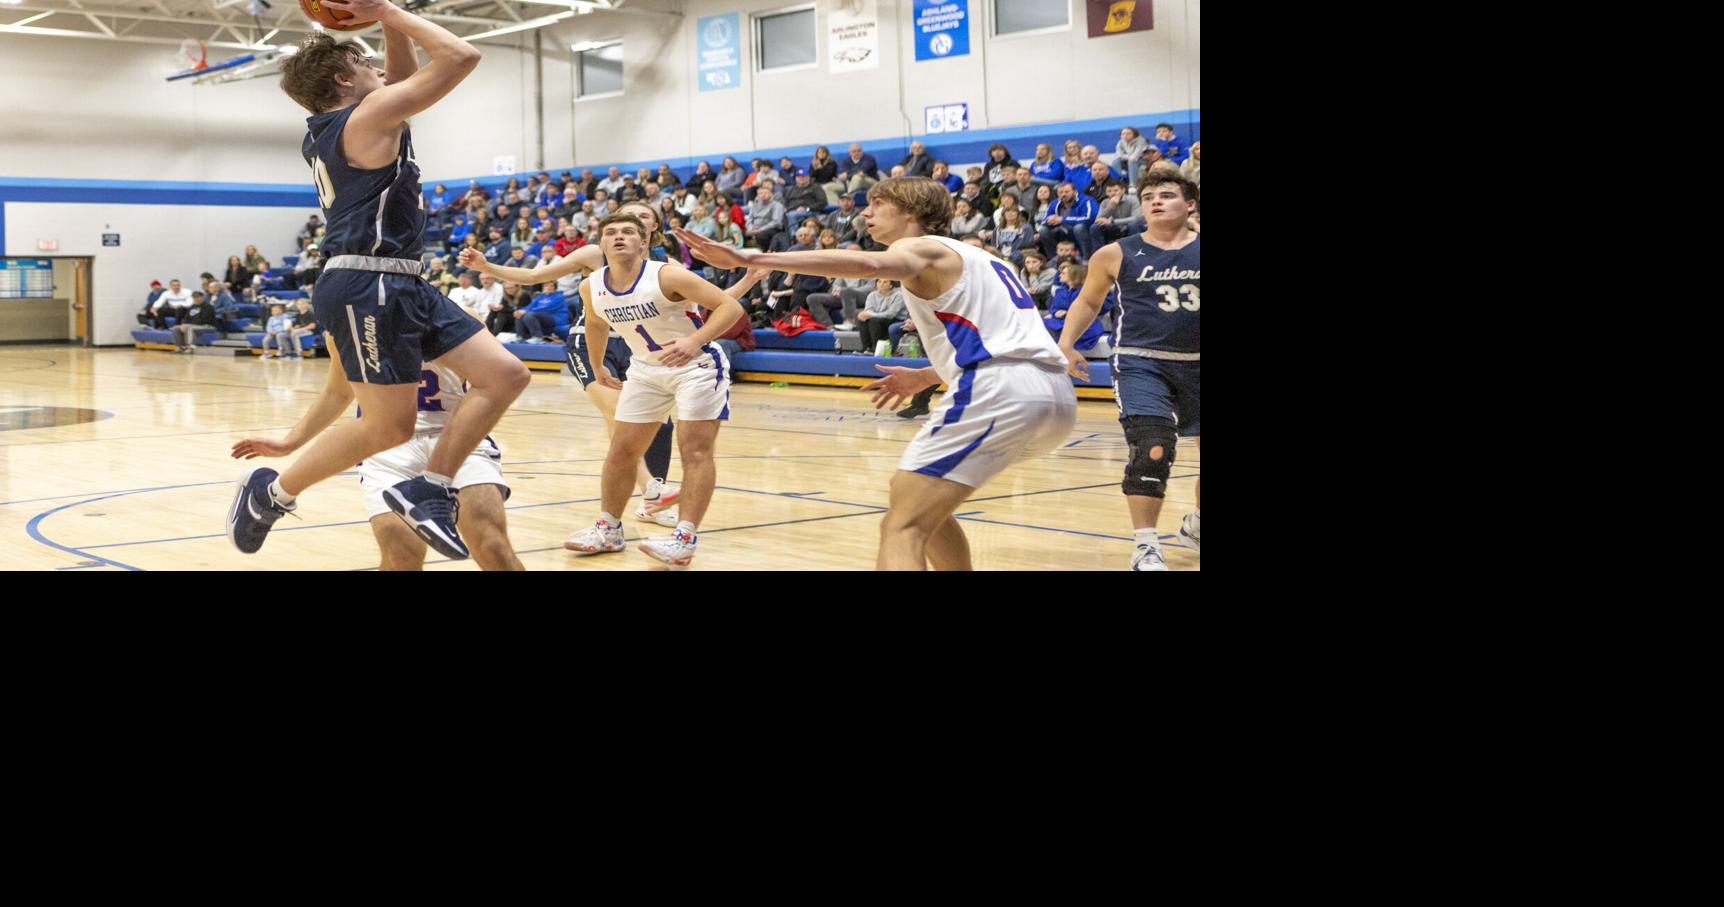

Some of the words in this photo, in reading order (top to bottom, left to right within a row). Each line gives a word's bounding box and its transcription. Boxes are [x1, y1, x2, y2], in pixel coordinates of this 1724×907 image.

[917, 10, 965, 26] GREENWOOD
[922, 20, 959, 33] BLUEJAYS
[839, 31, 867, 40] EAGLES
[990, 260, 1035, 309] 0
[1155, 284, 1200, 312] 33
[604, 301, 660, 323] CHRISTIAN
[362, 315, 381, 373] Lutheran
[635, 324, 663, 352] 1
[417, 369, 446, 412] 2
